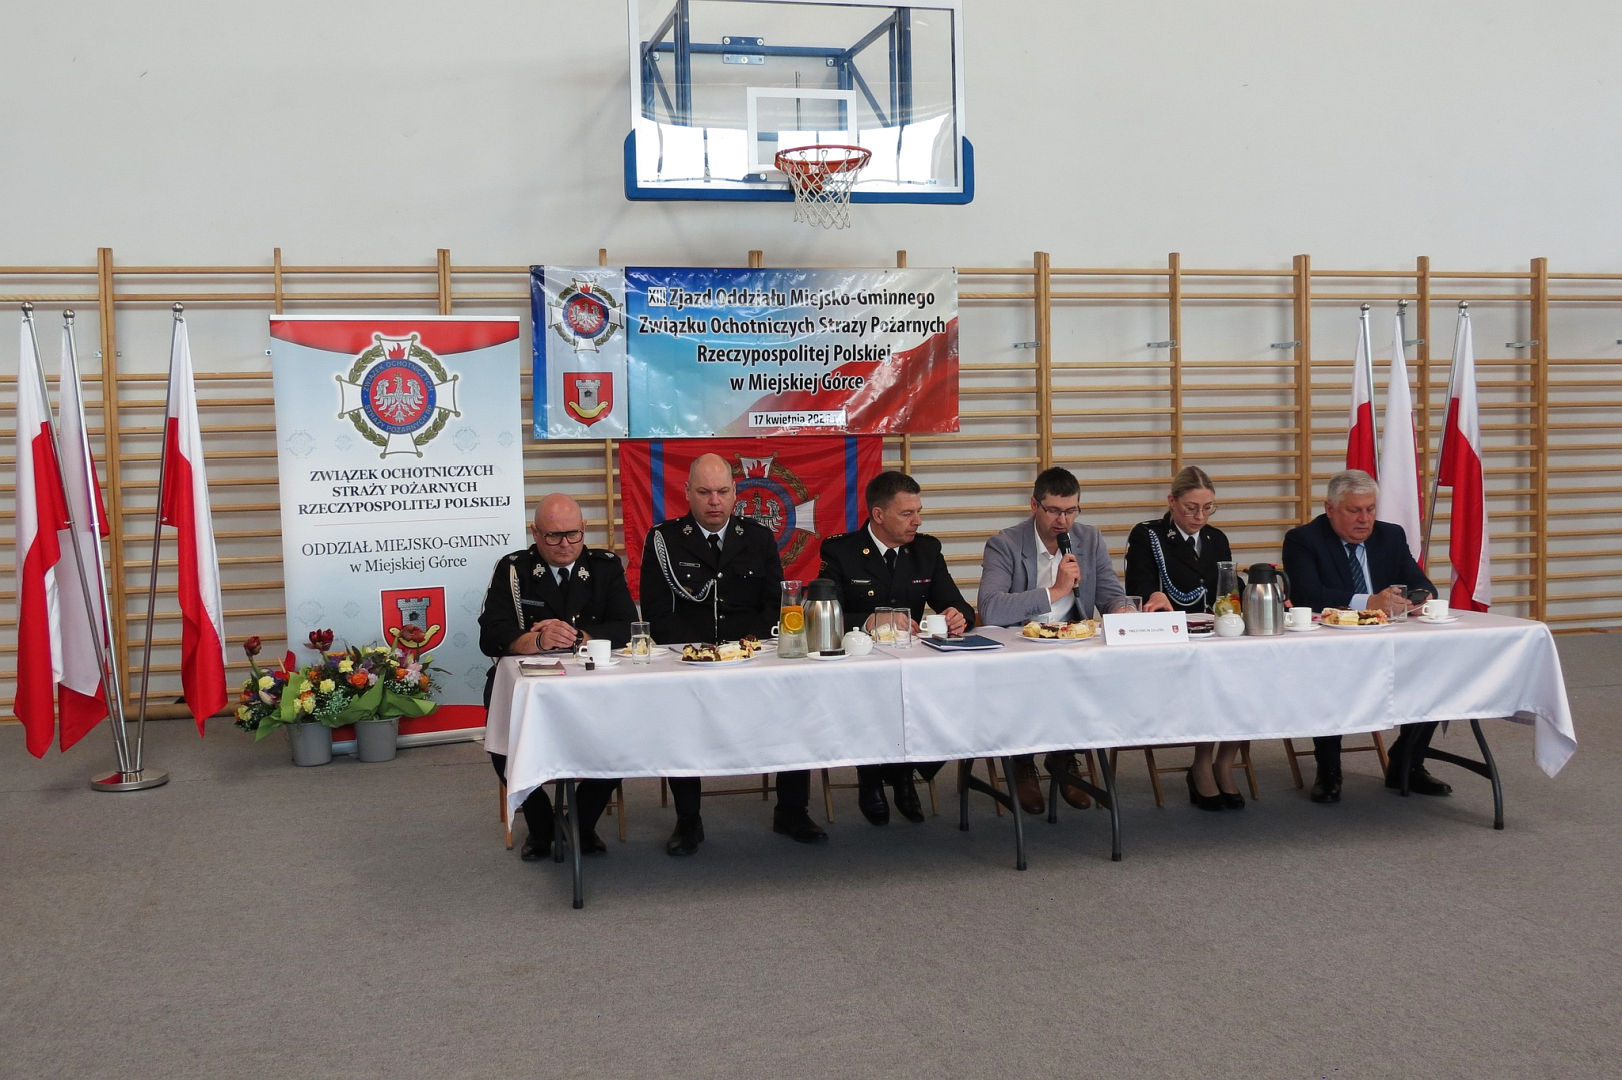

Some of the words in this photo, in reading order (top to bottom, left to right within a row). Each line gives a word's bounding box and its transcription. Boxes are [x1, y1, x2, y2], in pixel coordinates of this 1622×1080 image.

[648, 289, 666, 304] XIII
[670, 288, 712, 310] Zjazd
[716, 288, 785, 306] Oddziału
[790, 289, 934, 310] Miejsko-Gminnego
[639, 316, 706, 336] Związku
[711, 316, 814, 337] Ochotniczych
[819, 316, 867, 336] Straży
[872, 316, 945, 336] Pożarnych
[698, 344, 829, 366] Rzeczypospolitej
[730, 378, 744, 390] w
[748, 373, 818, 394] Miejskiej
[822, 372, 864, 390] Górce
[754, 415, 764, 424] 17
[766, 414, 805, 424] kwietnia
[808, 414, 831, 424] 202
[310, 468, 378, 483] ZWIĄZEK
[381, 464, 494, 479] OCHOTNICZYCH
[332, 483, 388, 497] STRAŻY
[391, 481, 478, 495] POŻARNYCH
[298, 500, 441, 514] RZECZYPOSPOLITEJ
[445, 496, 511, 509] POLSKIEJ
[302, 541, 372, 556] ODDZIAŁ
[376, 534, 511, 551] MIEJSKO-GMINNY
[350, 562, 362, 573] w
[365, 557, 426, 574] Miejskiej
[428, 556, 468, 569] Górce
